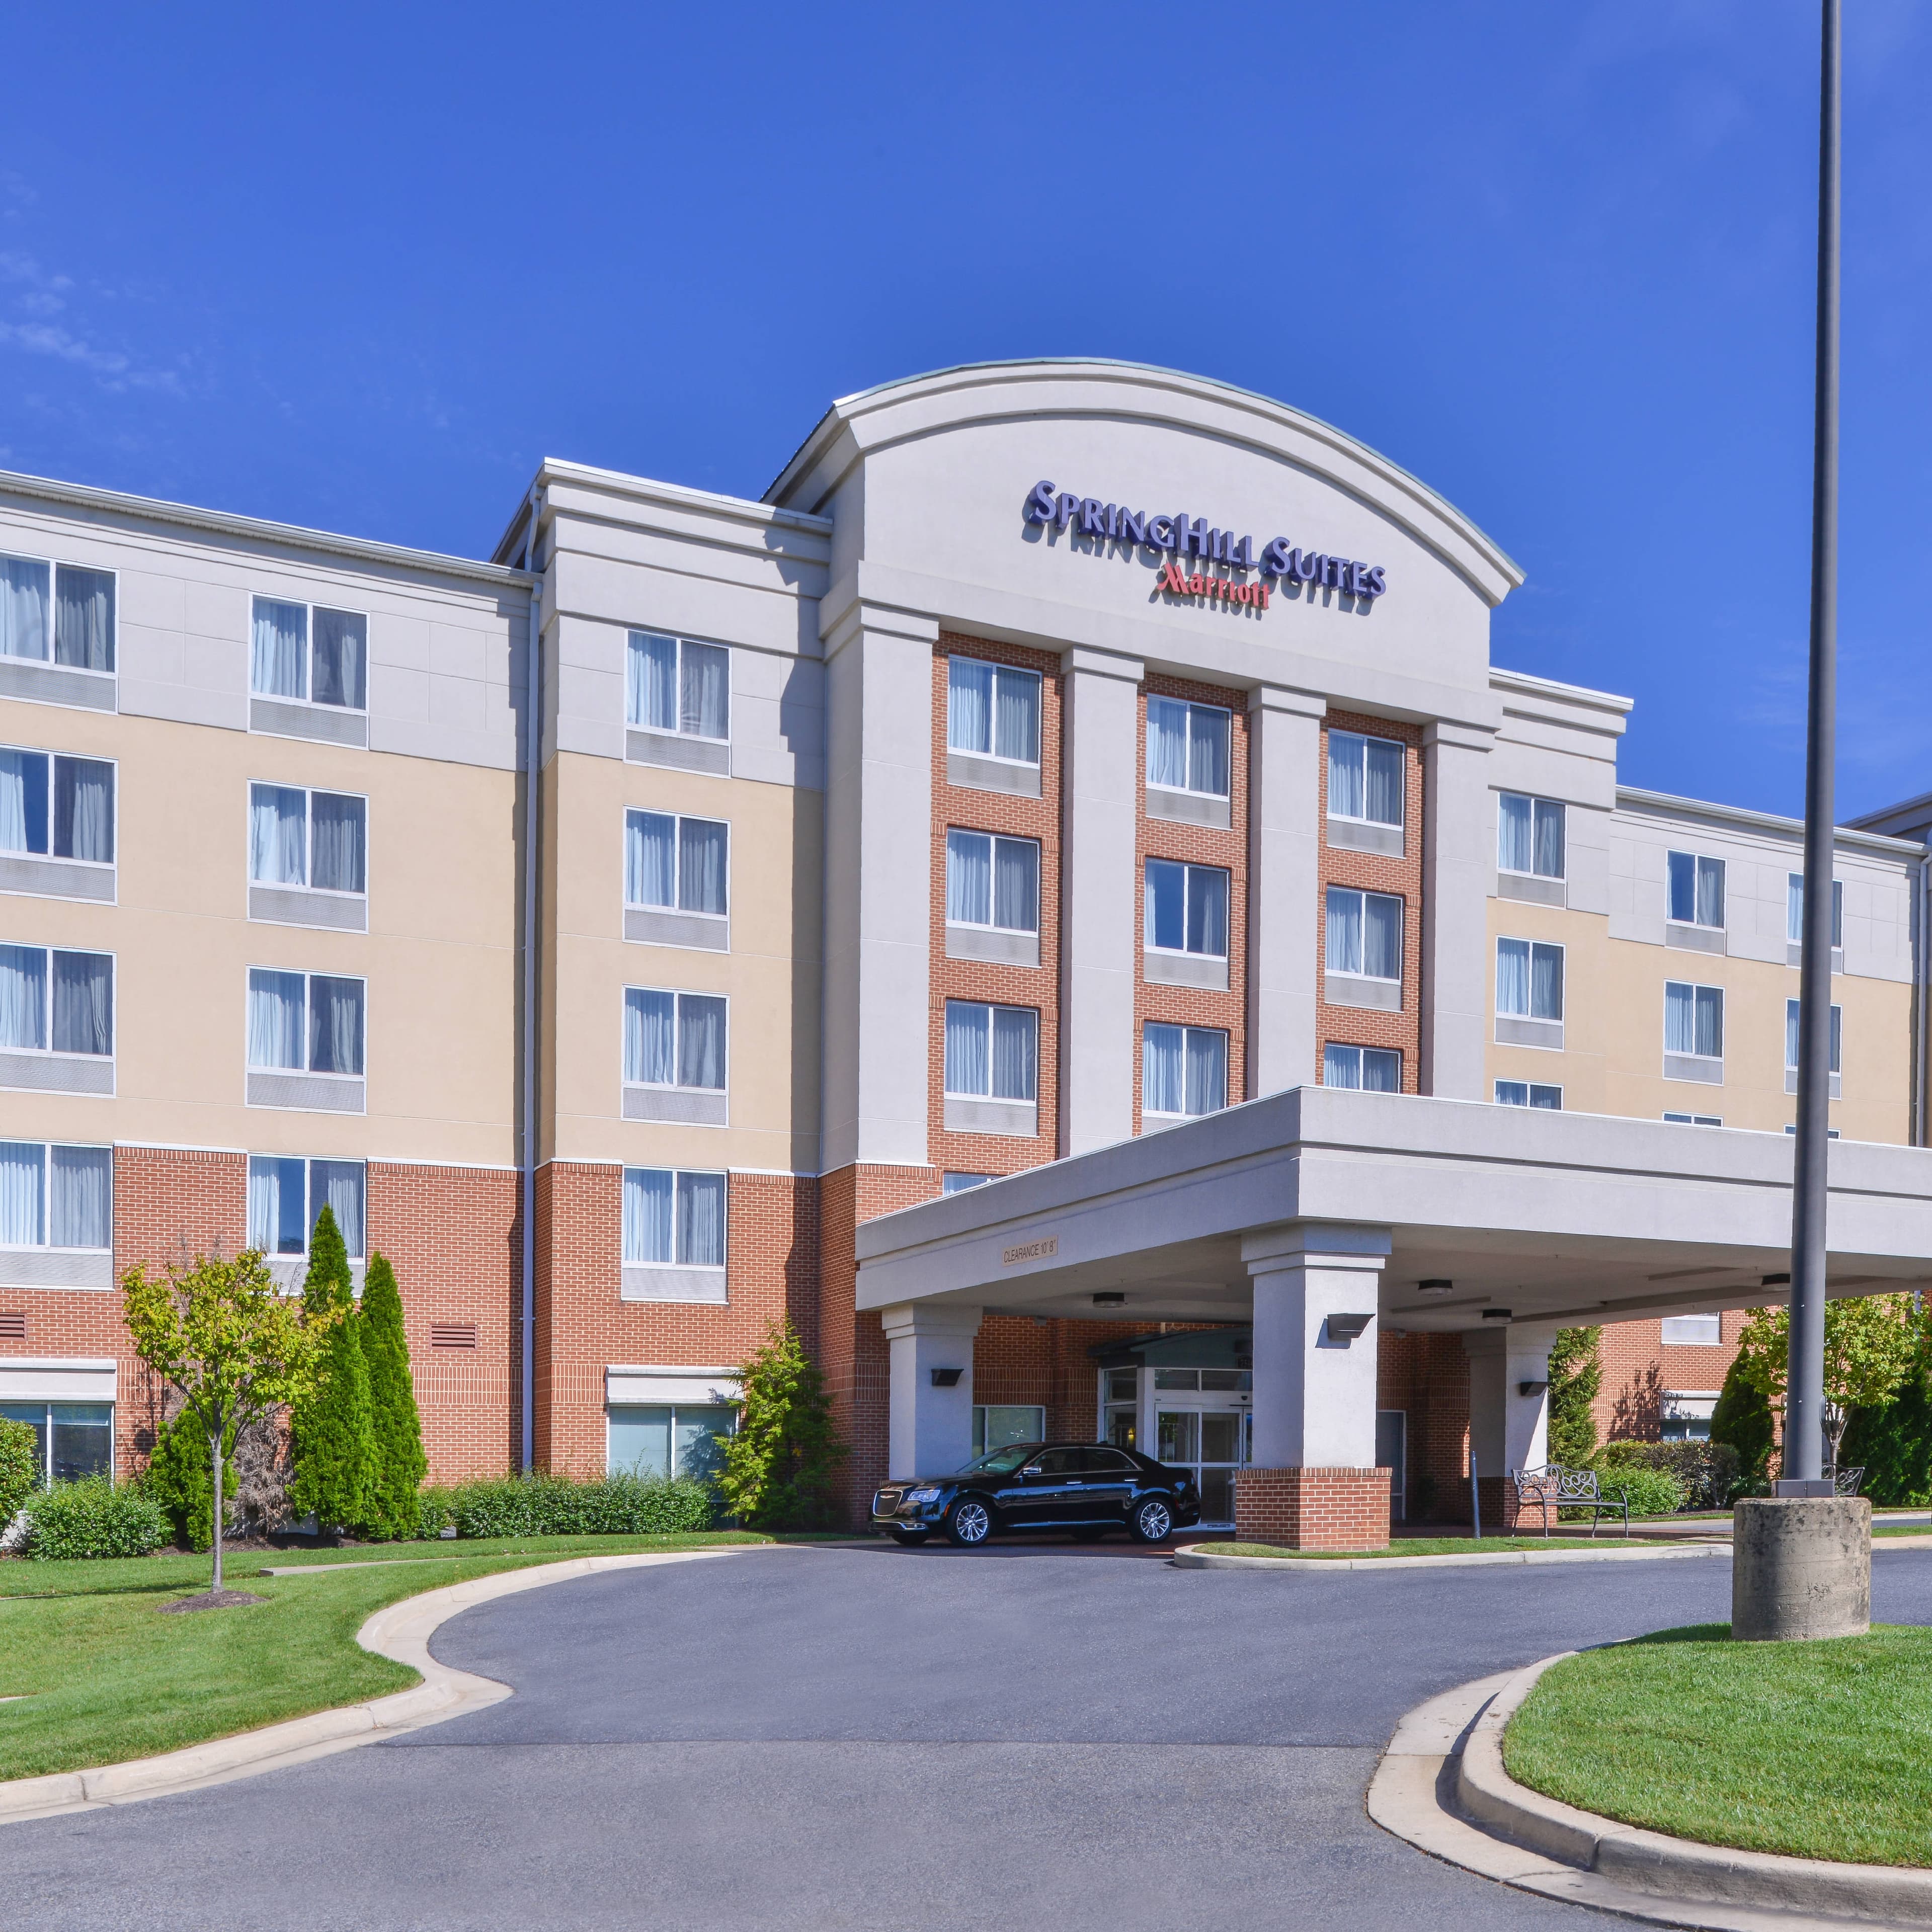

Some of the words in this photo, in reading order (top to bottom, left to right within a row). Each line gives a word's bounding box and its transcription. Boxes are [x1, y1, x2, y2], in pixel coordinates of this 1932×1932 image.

[1029, 480, 1258, 572] SPRINGHILL
[1263, 537, 1387, 600] SUITES
[1158, 561, 1269, 610] Marriott
[1004, 1244, 1039, 1263] CLEARANCE
